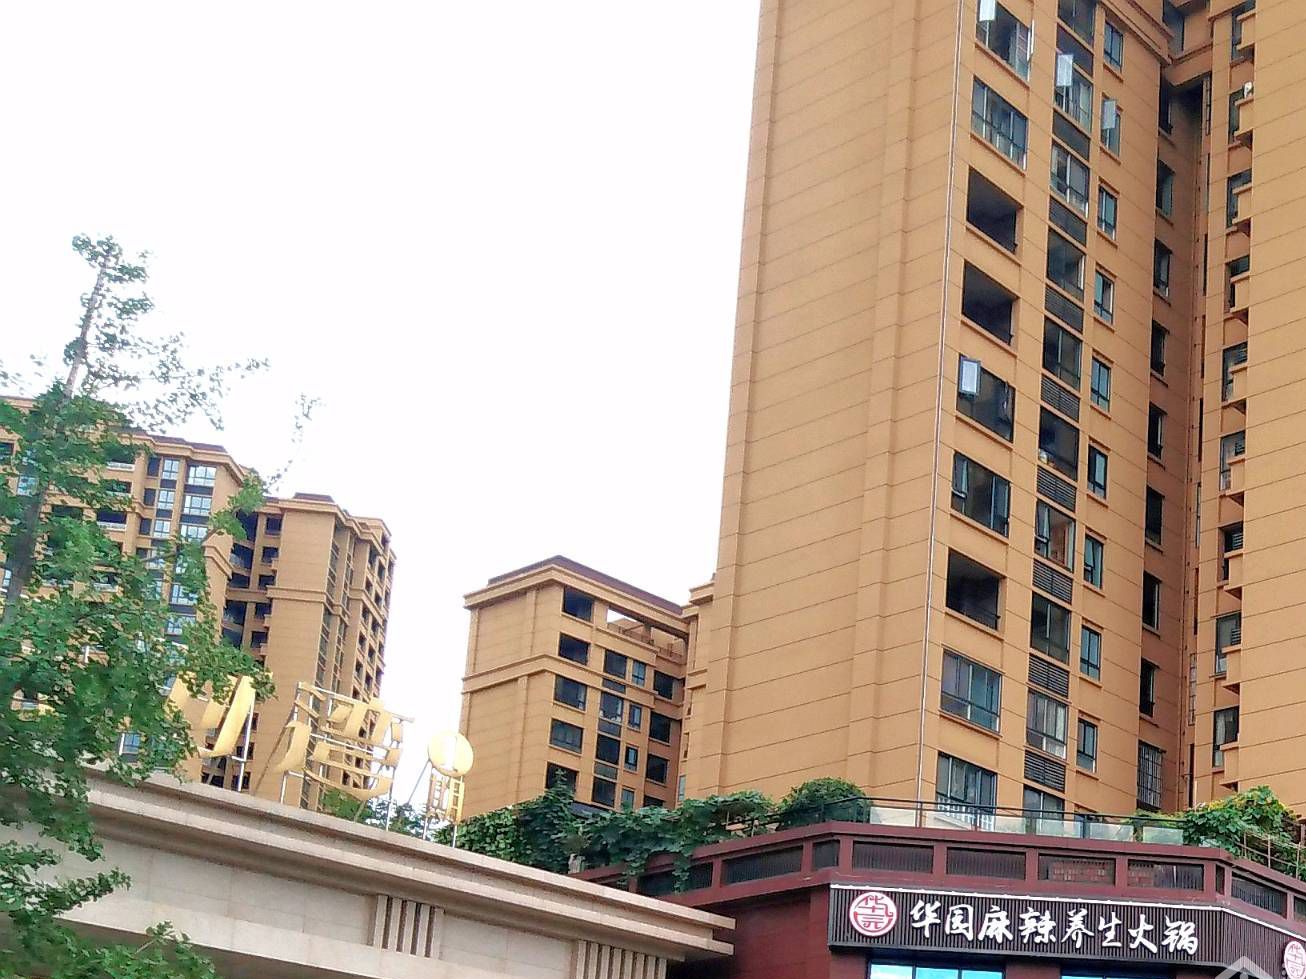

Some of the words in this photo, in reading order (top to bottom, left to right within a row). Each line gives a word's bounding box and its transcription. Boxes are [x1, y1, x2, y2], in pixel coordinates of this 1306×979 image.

[910, 900, 1198, 955] 华园麻辣养生火锅
